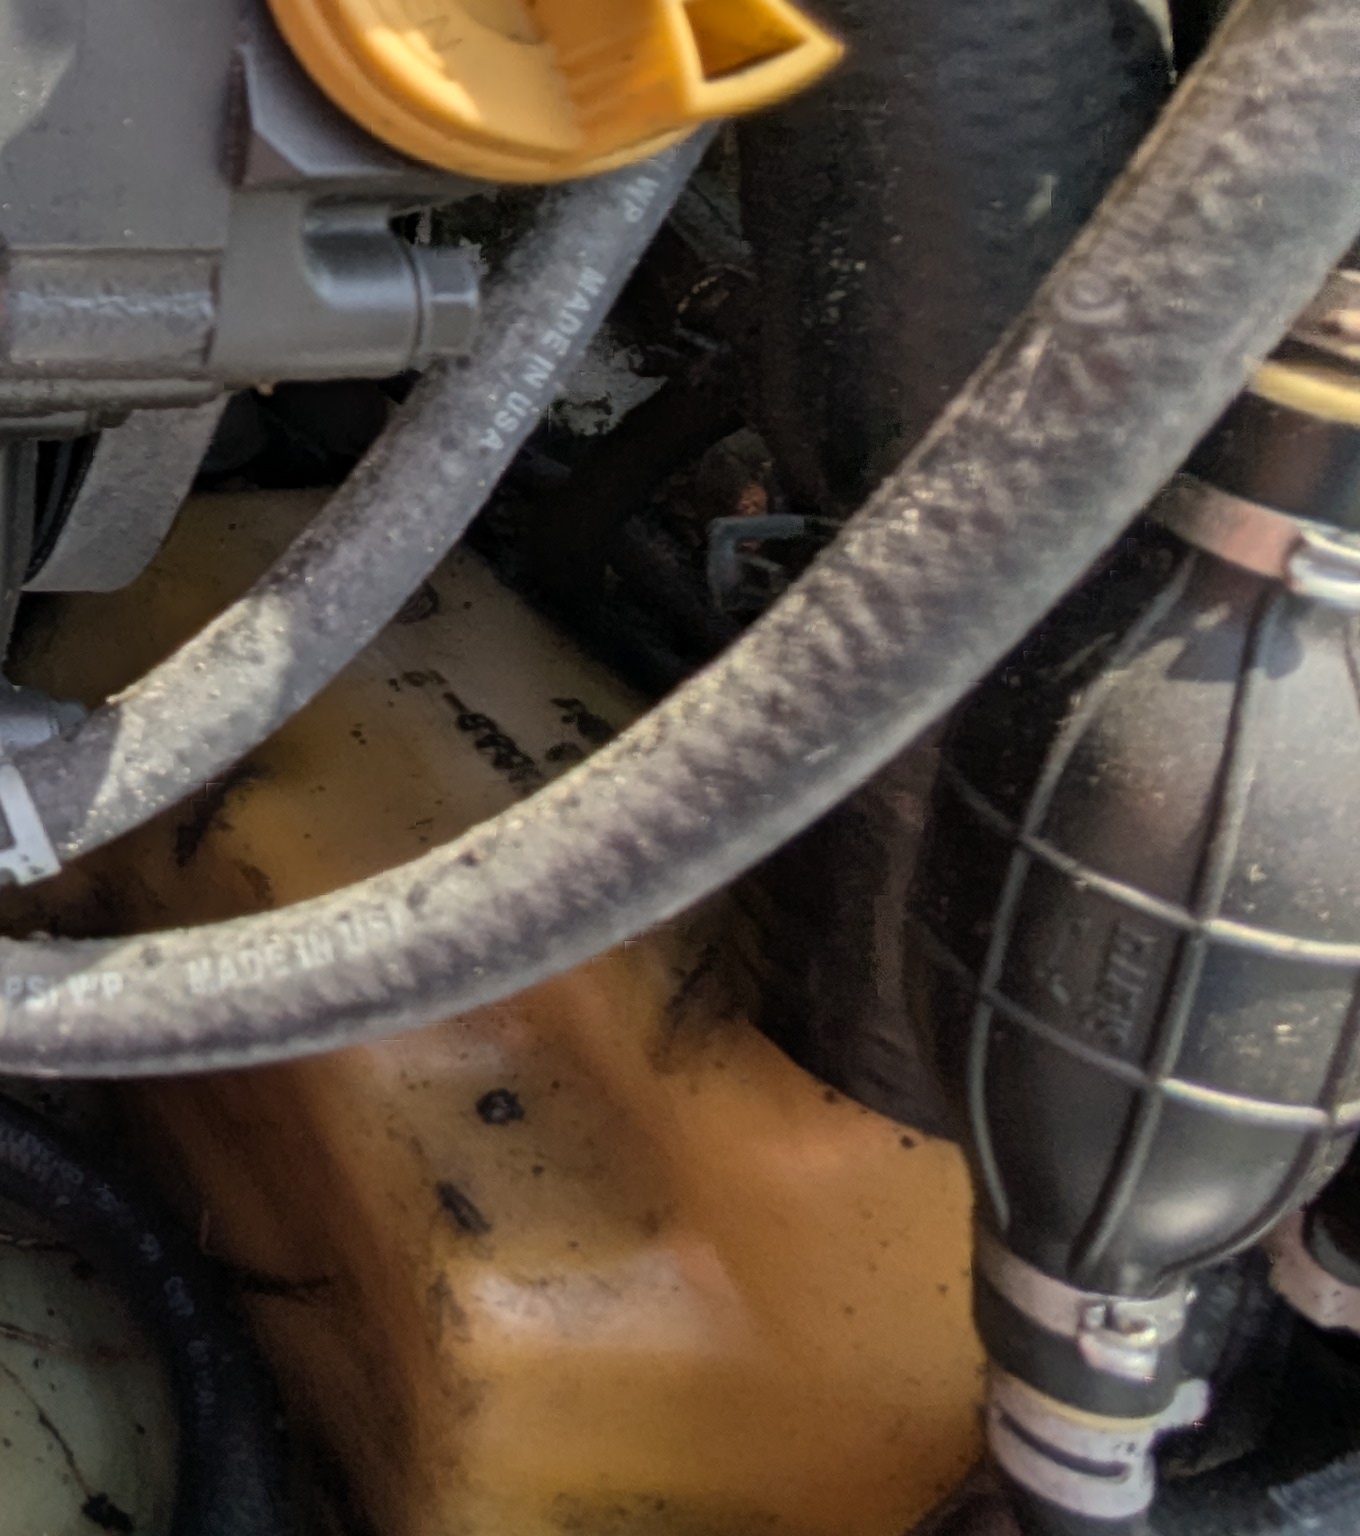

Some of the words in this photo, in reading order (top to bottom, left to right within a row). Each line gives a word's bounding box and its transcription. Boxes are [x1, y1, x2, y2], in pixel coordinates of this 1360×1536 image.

[540, 266, 608, 357] MADE
[523, 352, 556, 390] IN
[481, 390, 534, 451] USA
[187, 942, 290, 994] MADE
